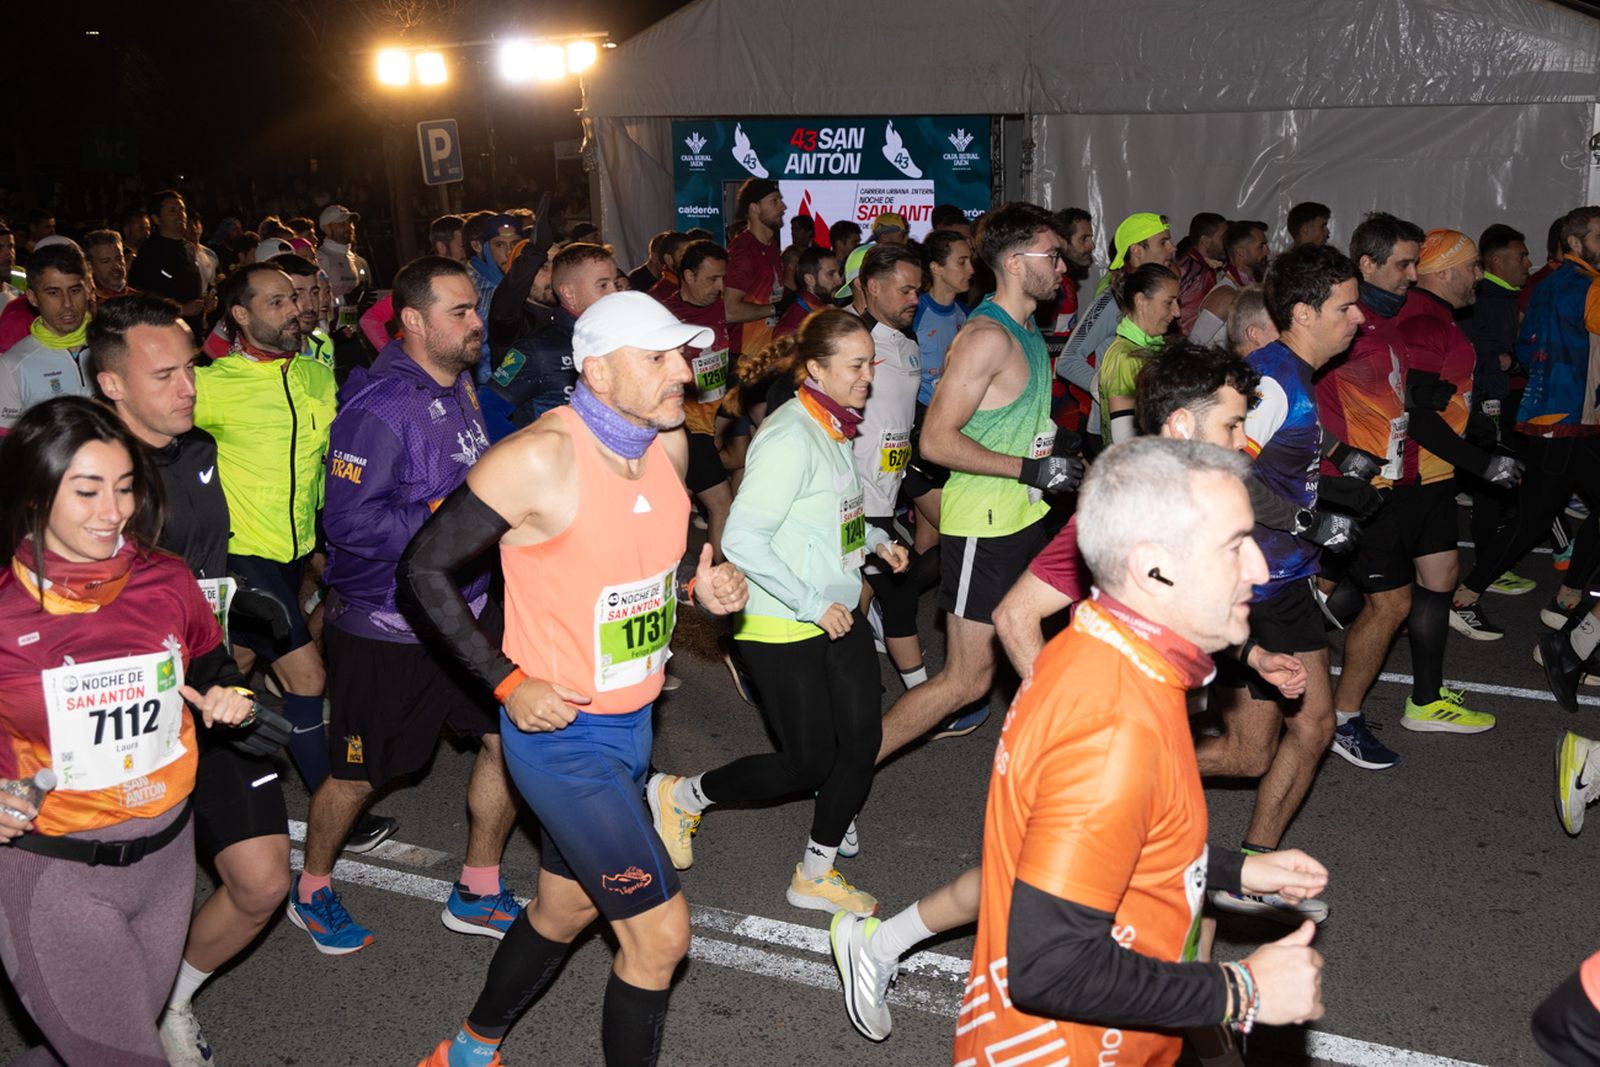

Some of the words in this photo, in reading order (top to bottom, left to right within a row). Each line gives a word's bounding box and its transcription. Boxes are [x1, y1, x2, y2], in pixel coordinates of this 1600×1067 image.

[790, 127, 817, 152] 43
[818, 127, 865, 149] SAN
[427, 127, 452, 177] P
[743, 153, 757, 170] 43
[784, 146, 862, 175] ANTÓN
[894, 152, 909, 170] 43
[678, 205, 719, 214] calderón
[859, 196, 883, 204] NOCHE
[884, 196, 895, 204] DE
[330, 457, 362, 485] TRAIL
[621, 590, 650, 606] NOCHE
[650, 585, 660, 598] DE
[607, 607, 629, 621] SAN
[622, 606, 667, 650] 1731
[82, 674, 125, 691] NOCHE
[128, 671, 144, 684] DE
[66, 694, 96, 711] SAN
[99, 684, 145, 705] ANTÓN
[89, 699, 161, 746] 7112
[116, 742, 138, 753] Laura
[121, 775, 150, 793] SAN
